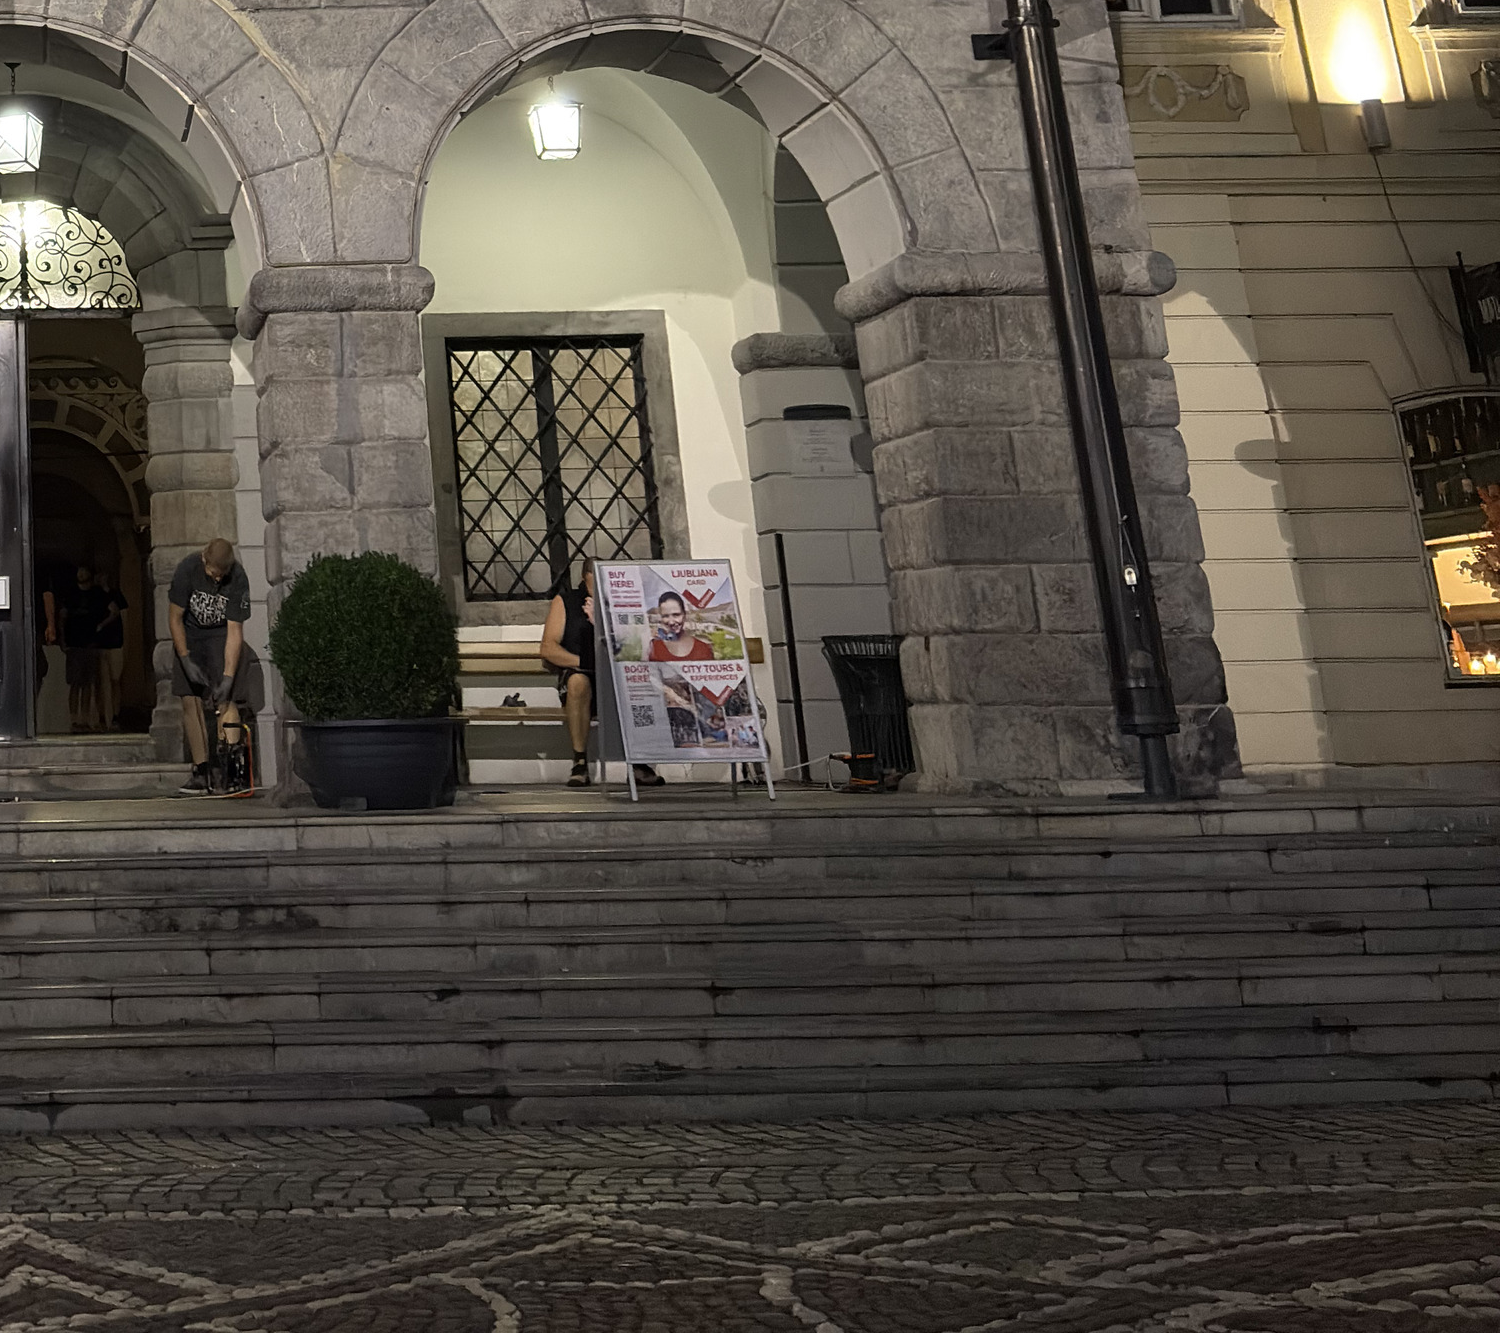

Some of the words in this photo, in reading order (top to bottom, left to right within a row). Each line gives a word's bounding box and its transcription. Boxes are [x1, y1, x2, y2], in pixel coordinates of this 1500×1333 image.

[608, 571, 626, 579] BUY
[682, 664, 702, 673] CITY
[703, 663, 734, 673] TOURS
